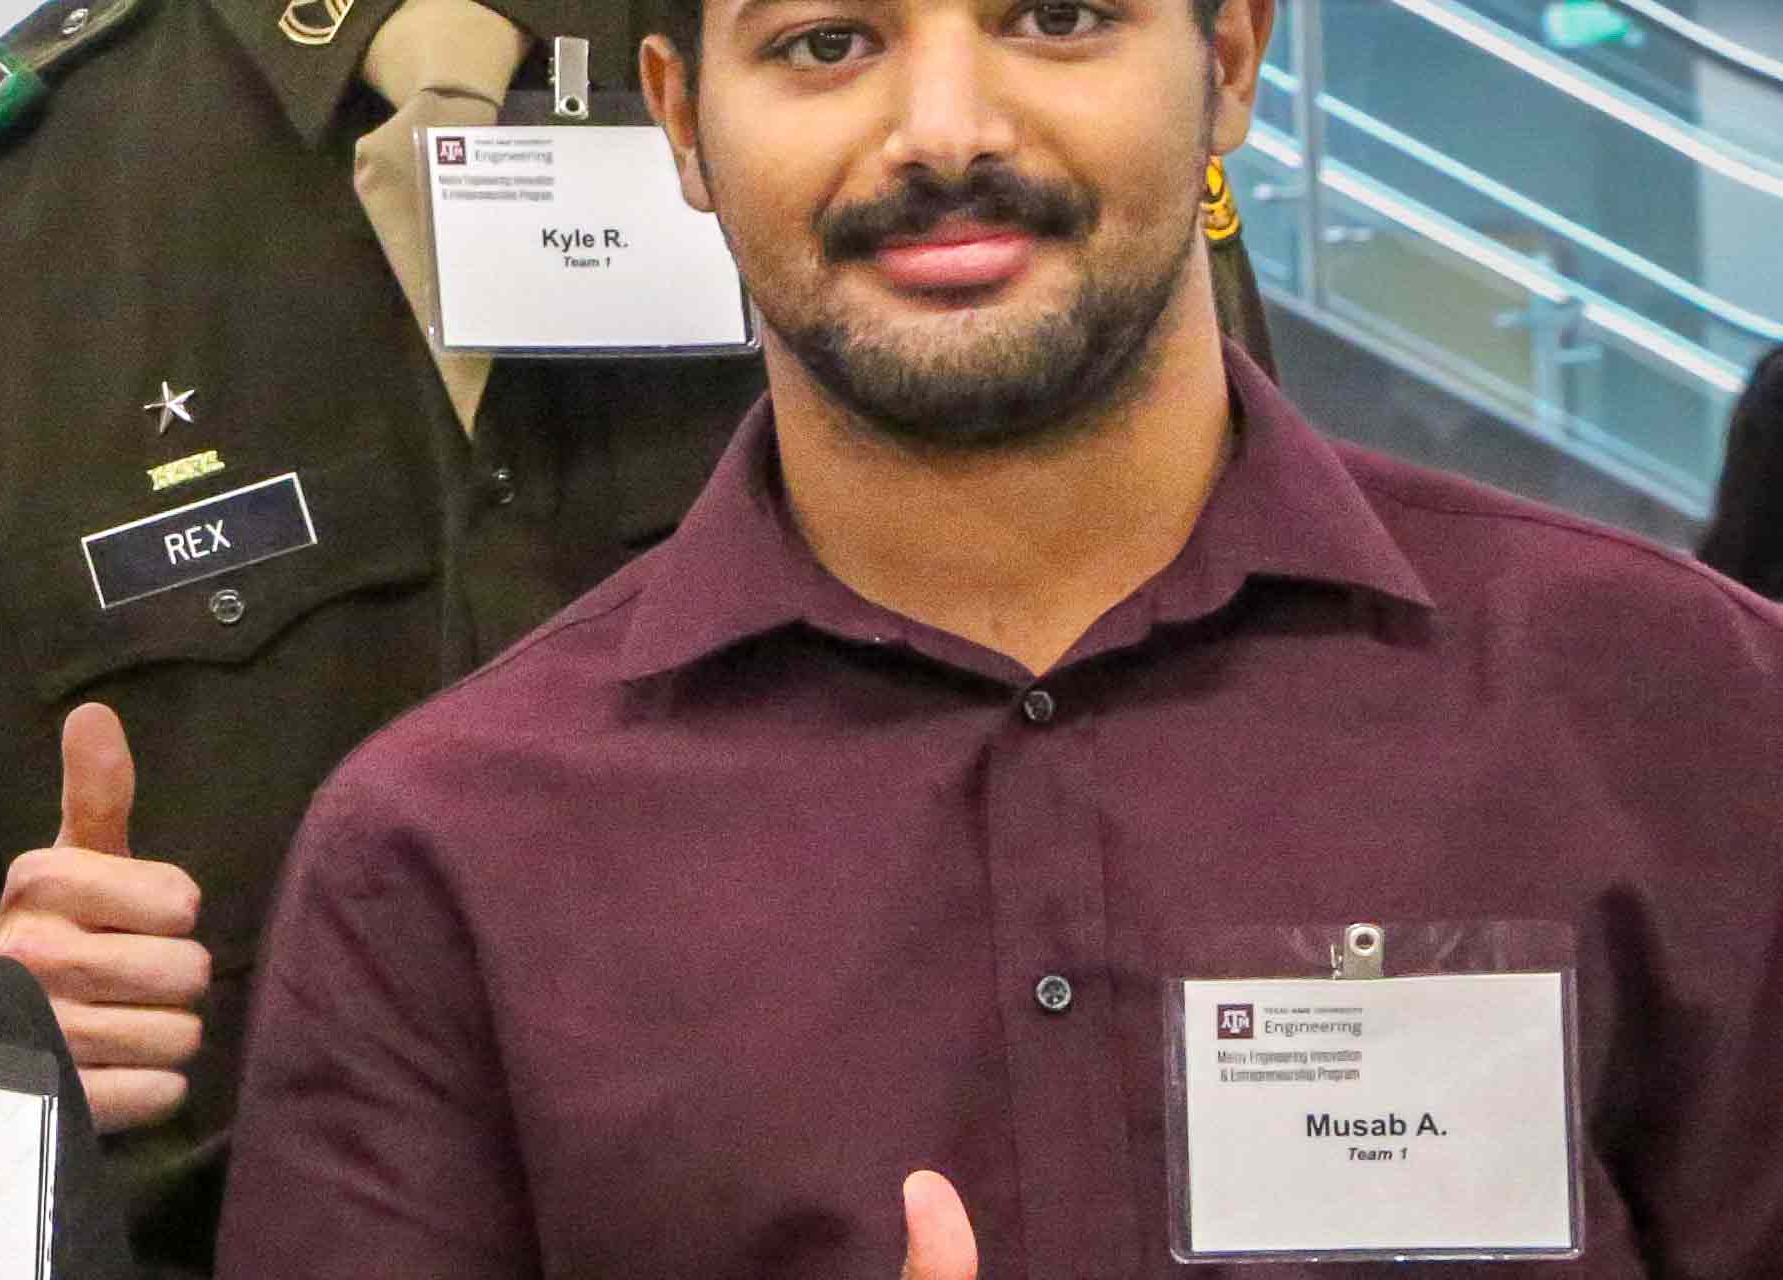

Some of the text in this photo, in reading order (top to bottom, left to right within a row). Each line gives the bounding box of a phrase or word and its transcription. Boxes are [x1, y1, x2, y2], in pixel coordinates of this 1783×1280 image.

[542, 228, 628, 253] Kyle R.
[563, 256, 610, 268] Team 1
[164, 519, 231, 565] REX
[1265, 1020, 1362, 1037] Engineering
[1306, 1112, 1447, 1137] Musab A.
[1348, 1147, 1408, 1160] Team 1
